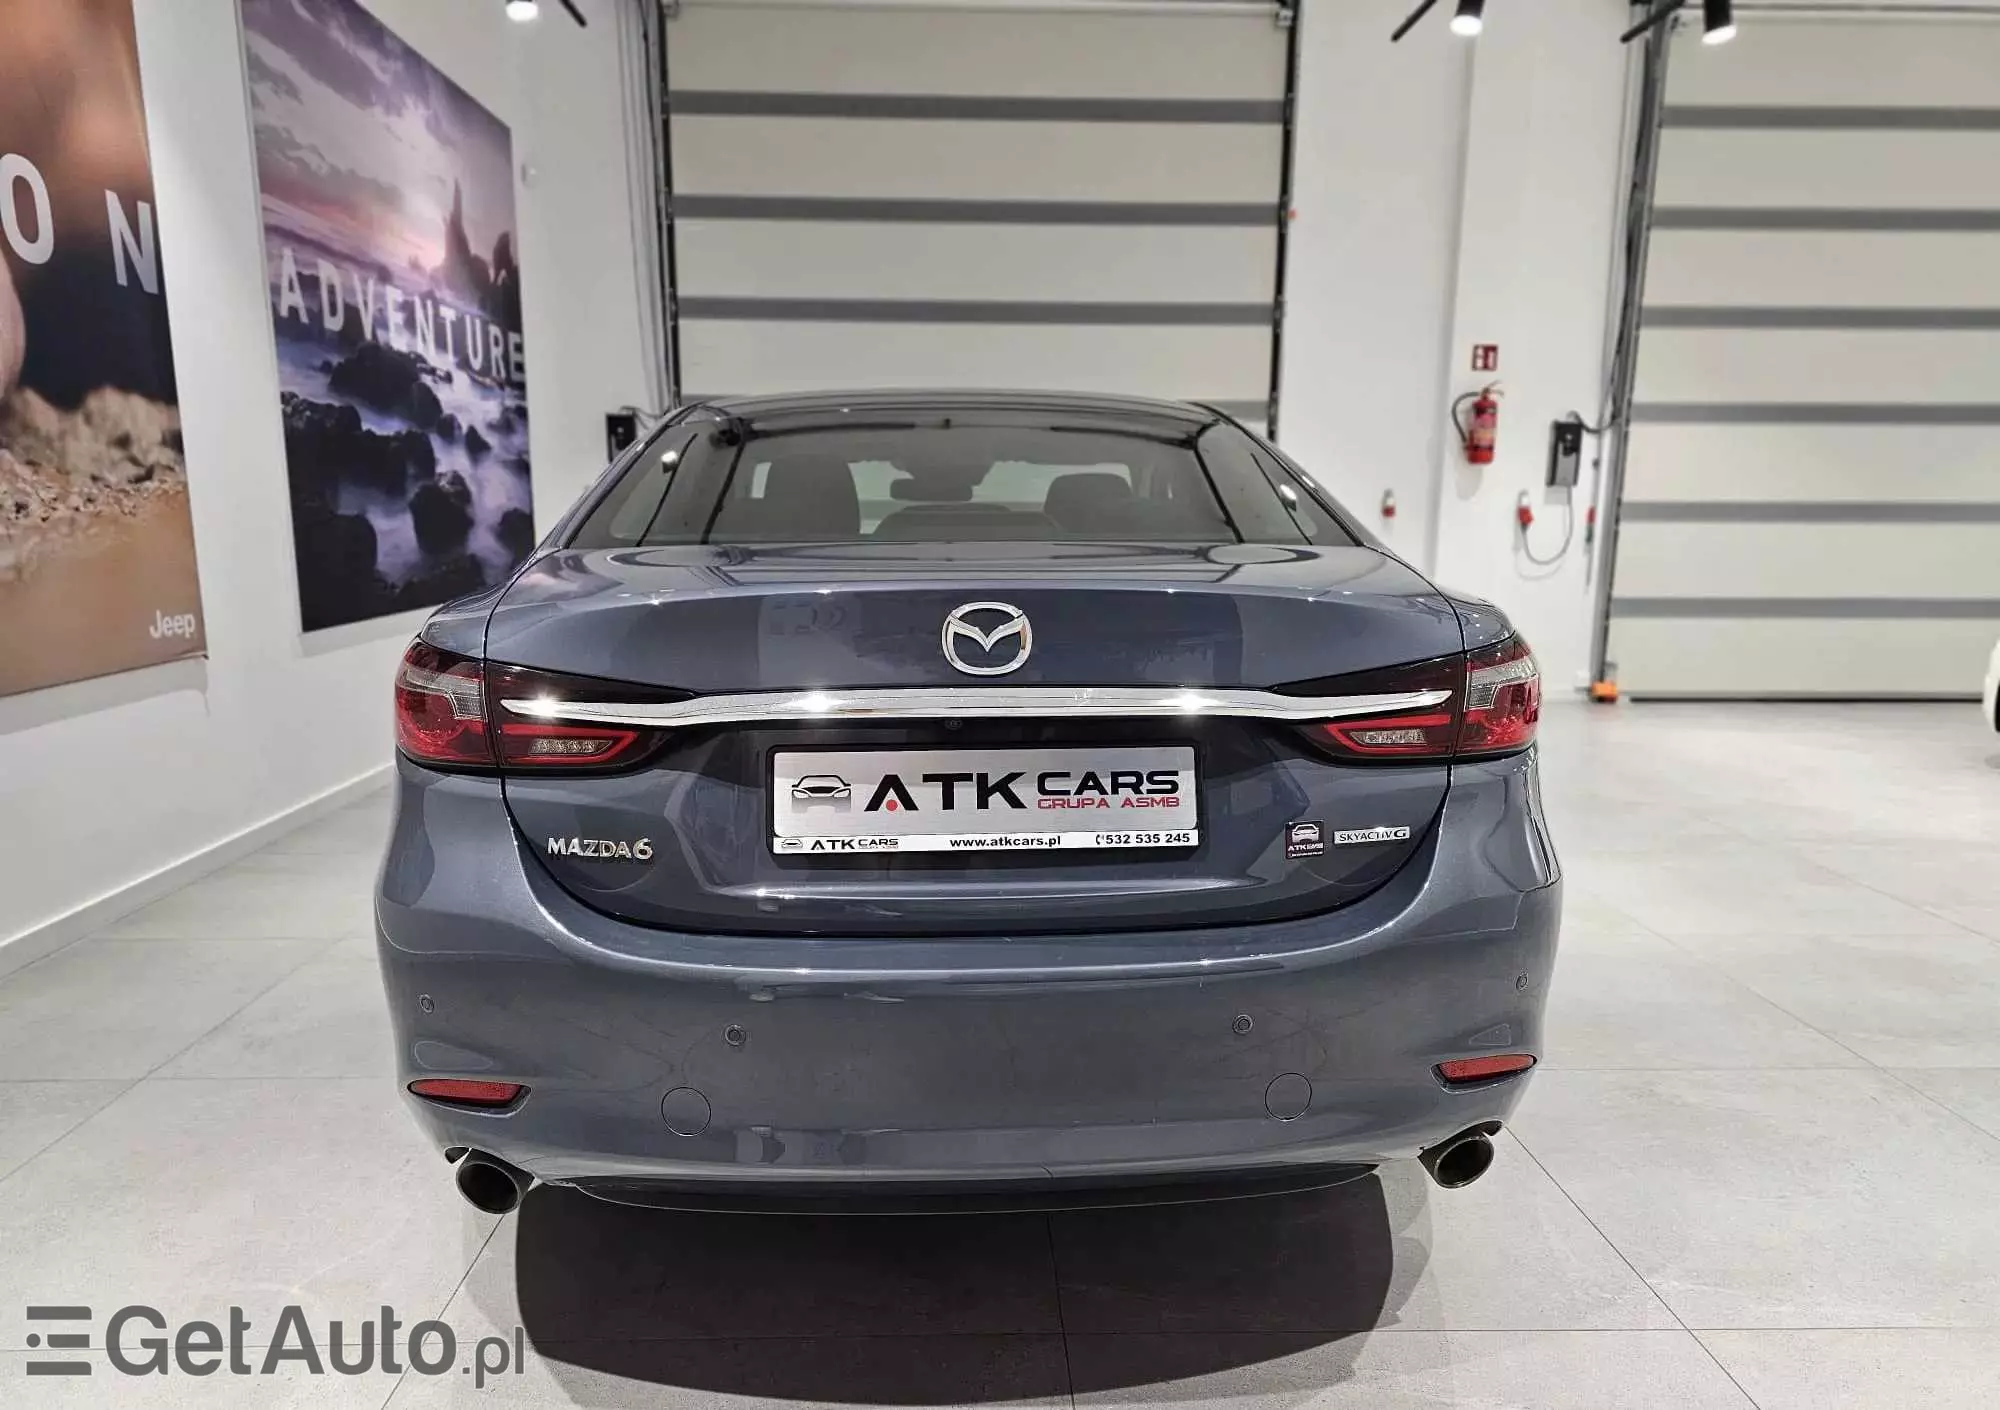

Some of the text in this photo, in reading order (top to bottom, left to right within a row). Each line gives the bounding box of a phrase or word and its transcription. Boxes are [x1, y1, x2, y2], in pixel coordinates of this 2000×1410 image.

[280, 246, 525, 383] ADVENTURE
[149, 609, 195, 639] Jeep
[863, 770, 1180, 812] ATK CARS
[1037, 796, 1180, 810] GRUPA ASMB
[811, 839, 855, 850] ATK
[858, 838, 899, 846] CARS
[949, 835, 1061, 850] www.atkcars.pl
[1105, 832, 1190, 845] 532 535 245
